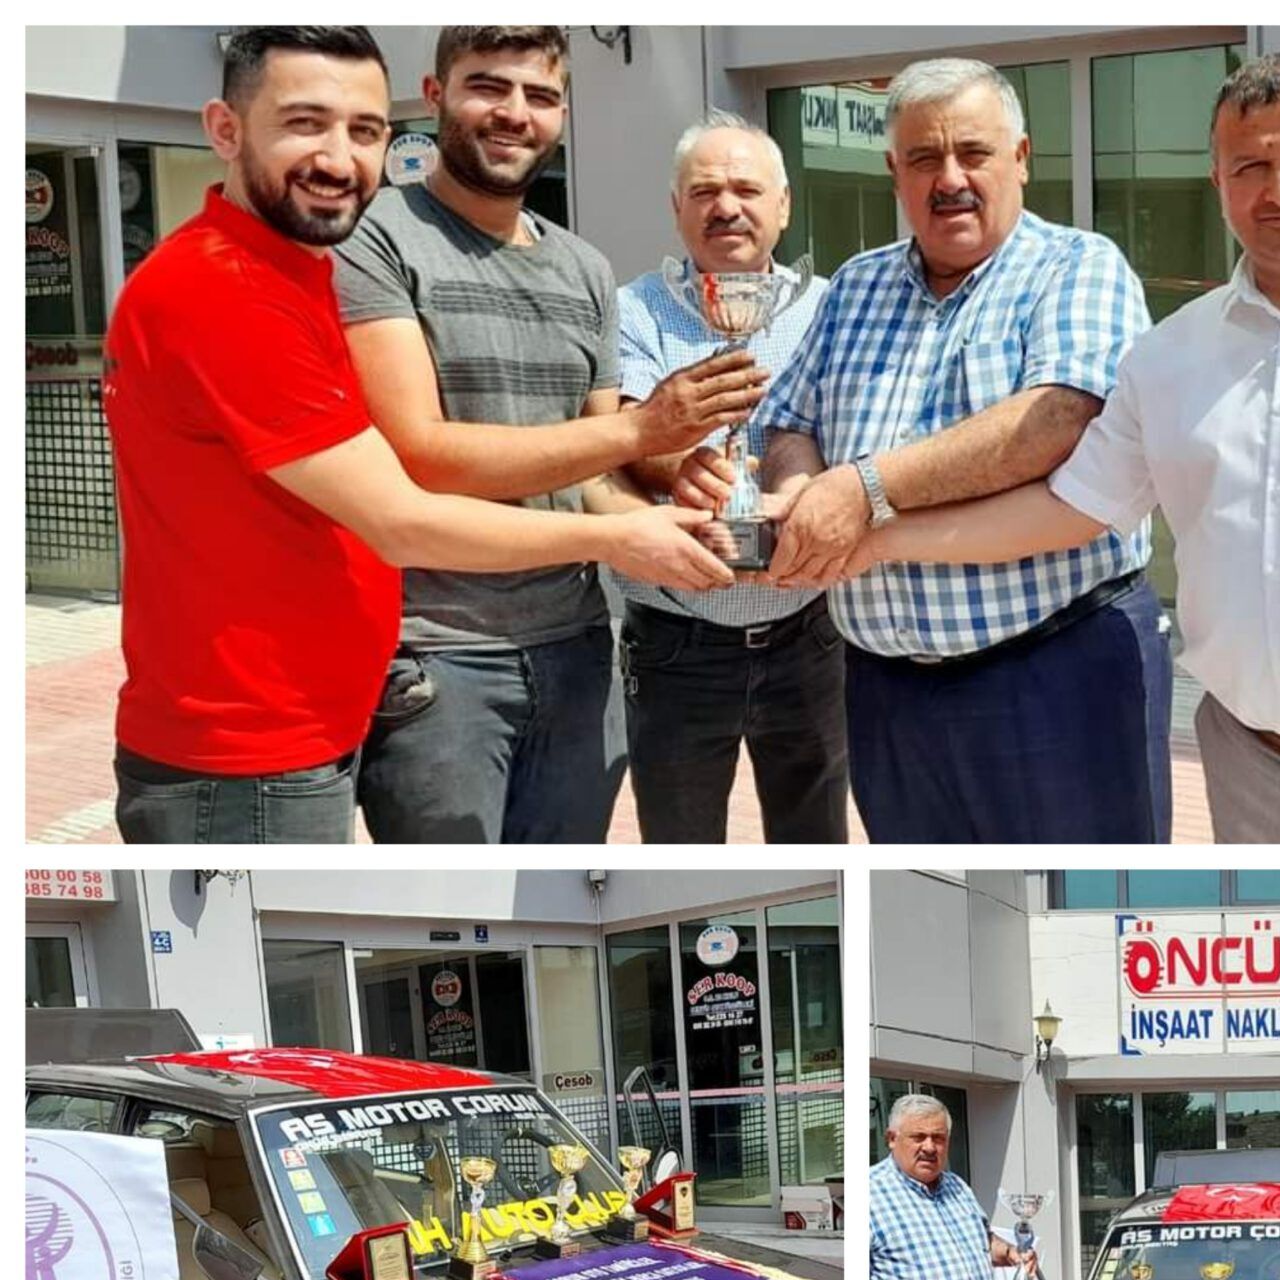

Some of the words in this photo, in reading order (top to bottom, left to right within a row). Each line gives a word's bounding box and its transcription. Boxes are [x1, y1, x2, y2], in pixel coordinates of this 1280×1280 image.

[56, 870, 77, 882] 00
[82, 871, 103, 884] 58
[57, 884, 79, 897] 74
[83, 886, 104, 899] 98
[687, 975, 713, 1005] SER
[715, 973, 757, 997] KOOP
[1131, 1003, 1214, 1047] İNŞAAT
[554, 1074, 593, 1092] Çesob
[279, 1113, 335, 1143] AS
[337, 1097, 452, 1132] MOTOR
[1159, 1225, 1242, 1241] MOTOR
